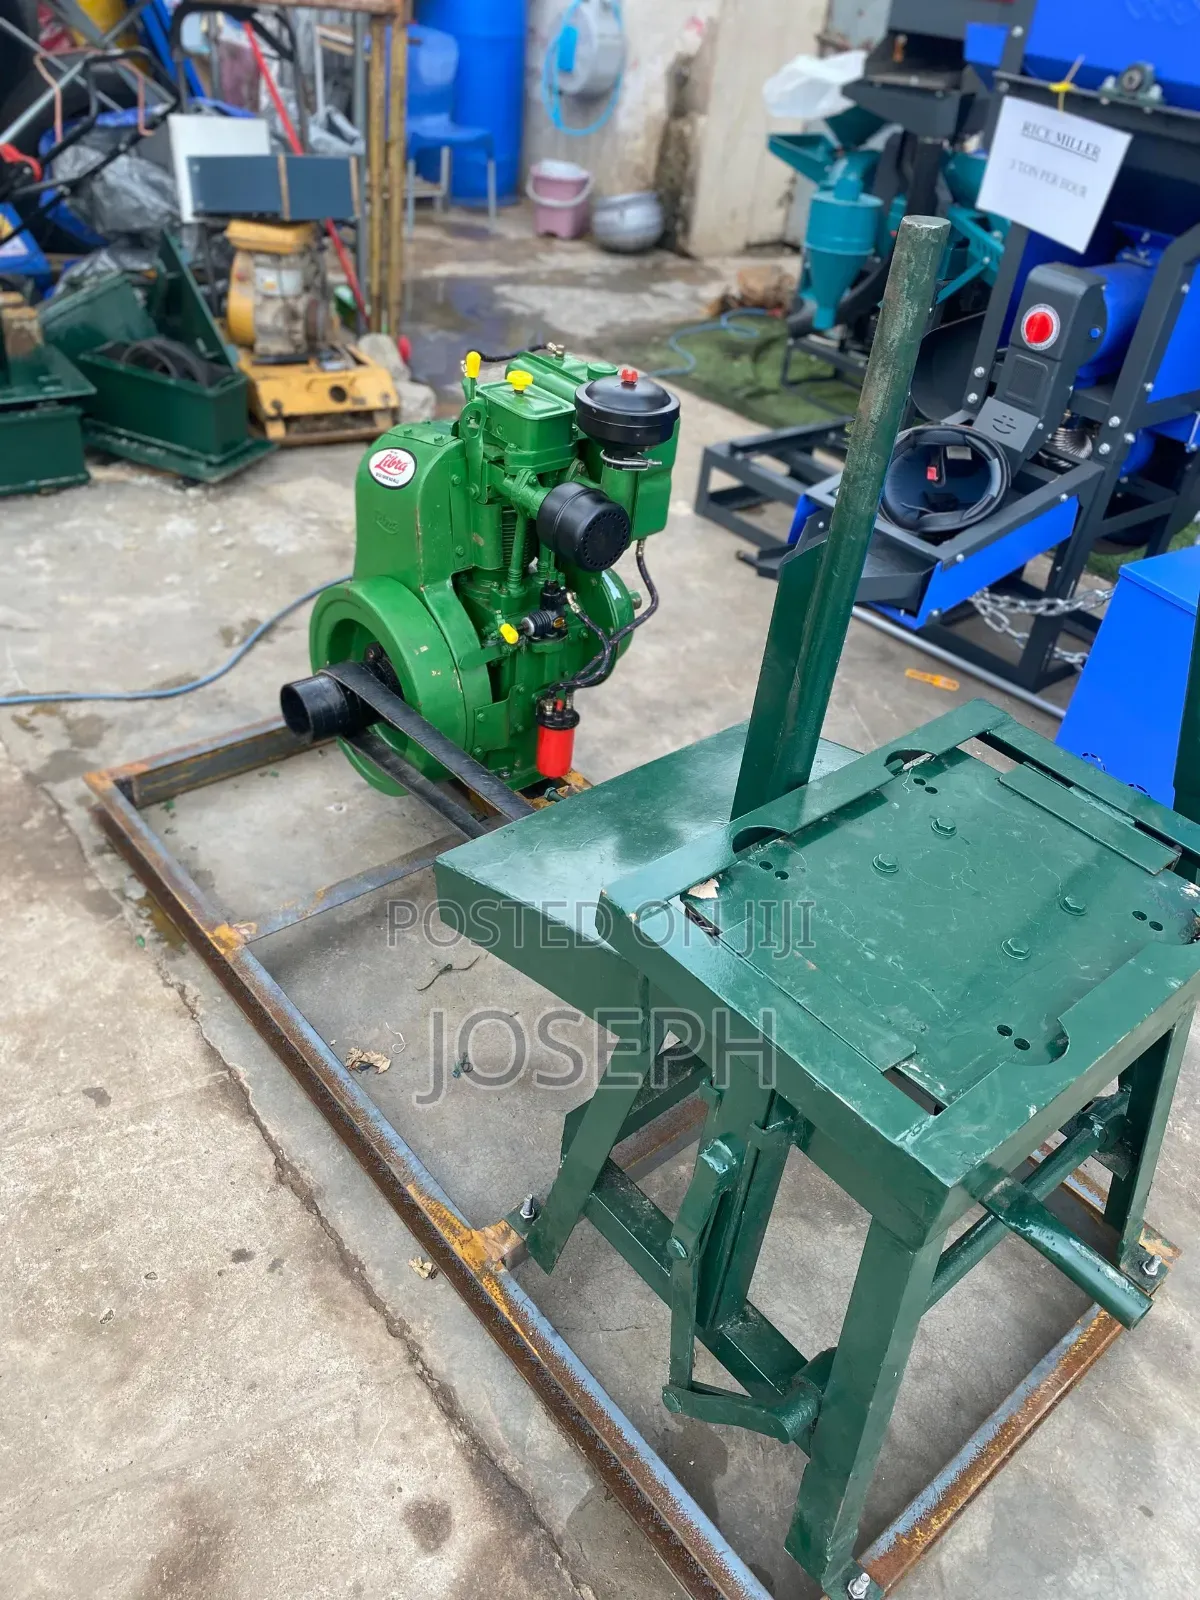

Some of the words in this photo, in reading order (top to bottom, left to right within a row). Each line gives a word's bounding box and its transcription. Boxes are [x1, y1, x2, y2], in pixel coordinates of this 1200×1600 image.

[1021, 120, 1054, 139] RICE
[1056, 131, 1101, 160] MILLER
[1018, 160, 1038, 178] TON
[1039, 169, 1059, 187] PER
[374, 453, 409, 475] Libra
